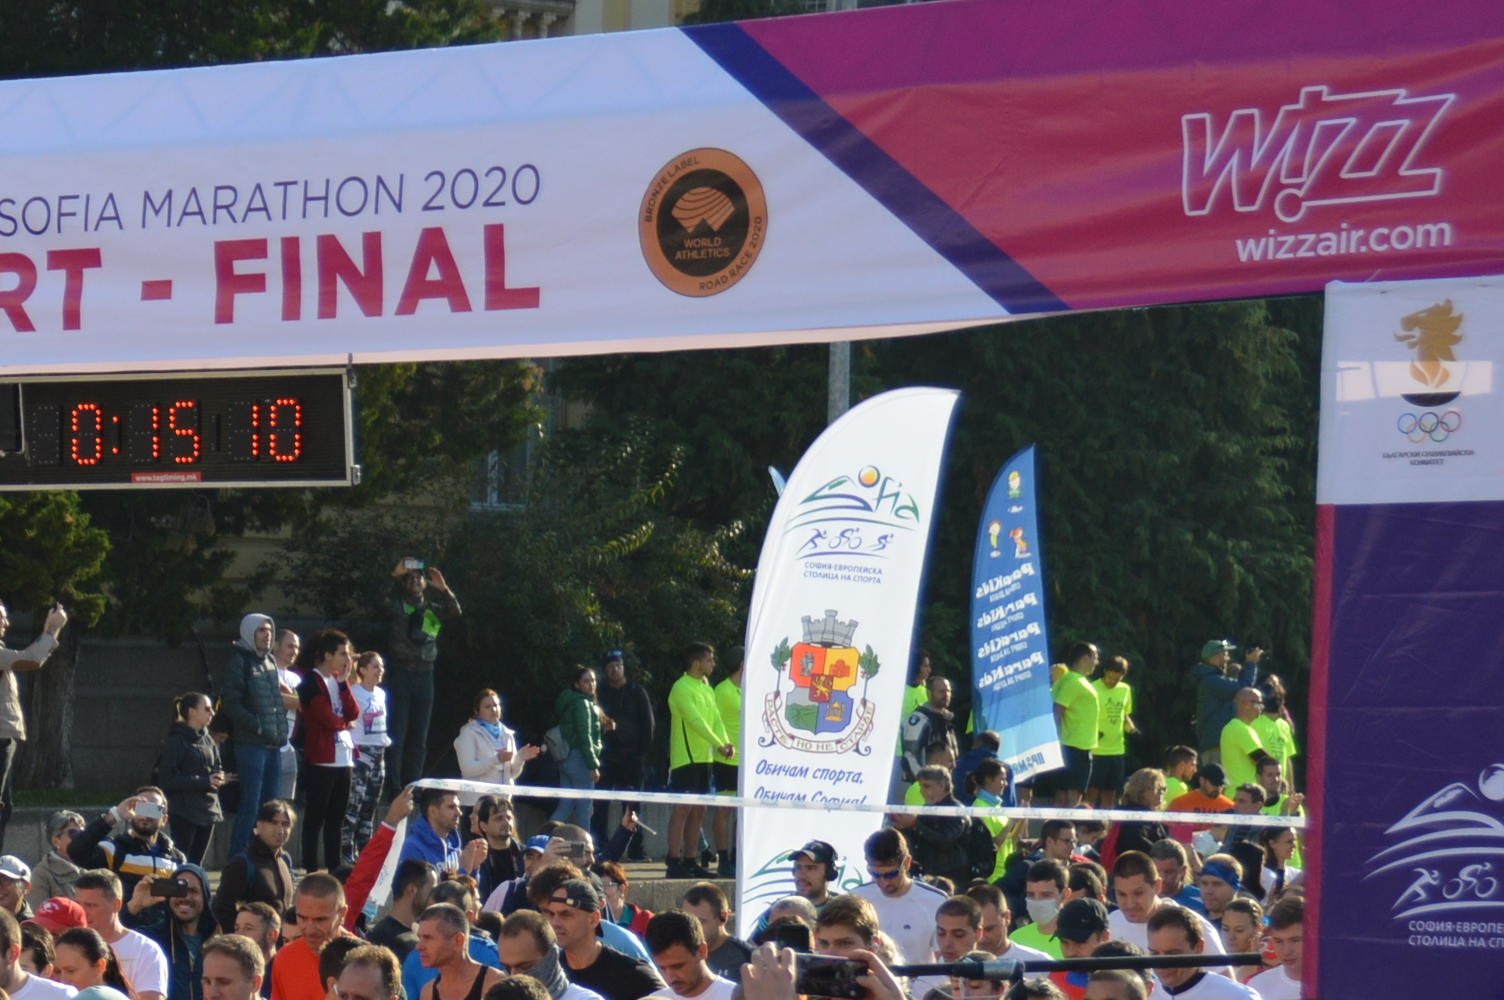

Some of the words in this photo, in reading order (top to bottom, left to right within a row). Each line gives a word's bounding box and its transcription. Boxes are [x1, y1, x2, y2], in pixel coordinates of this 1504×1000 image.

[141, 173, 404, 229] MARATHON
[421, 163, 541, 211] 2020
[674, 247, 731, 260] ATHLETICS
[683, 237, 722, 249] WORLD
[1235, 222, 1451, 262] wizzair.com
[141, 279, 173, 301] -
[213, 223, 541, 324] FINAL
[698, 273, 729, 291] ROAD
[729, 251, 752, 278] RACE
[755, 759, 809, 779] Обичам
[812, 765, 864, 785] спорта.
[1408, 935, 1465, 947] СТОЛИЦА
[1468, 938, 1486, 948] НА
